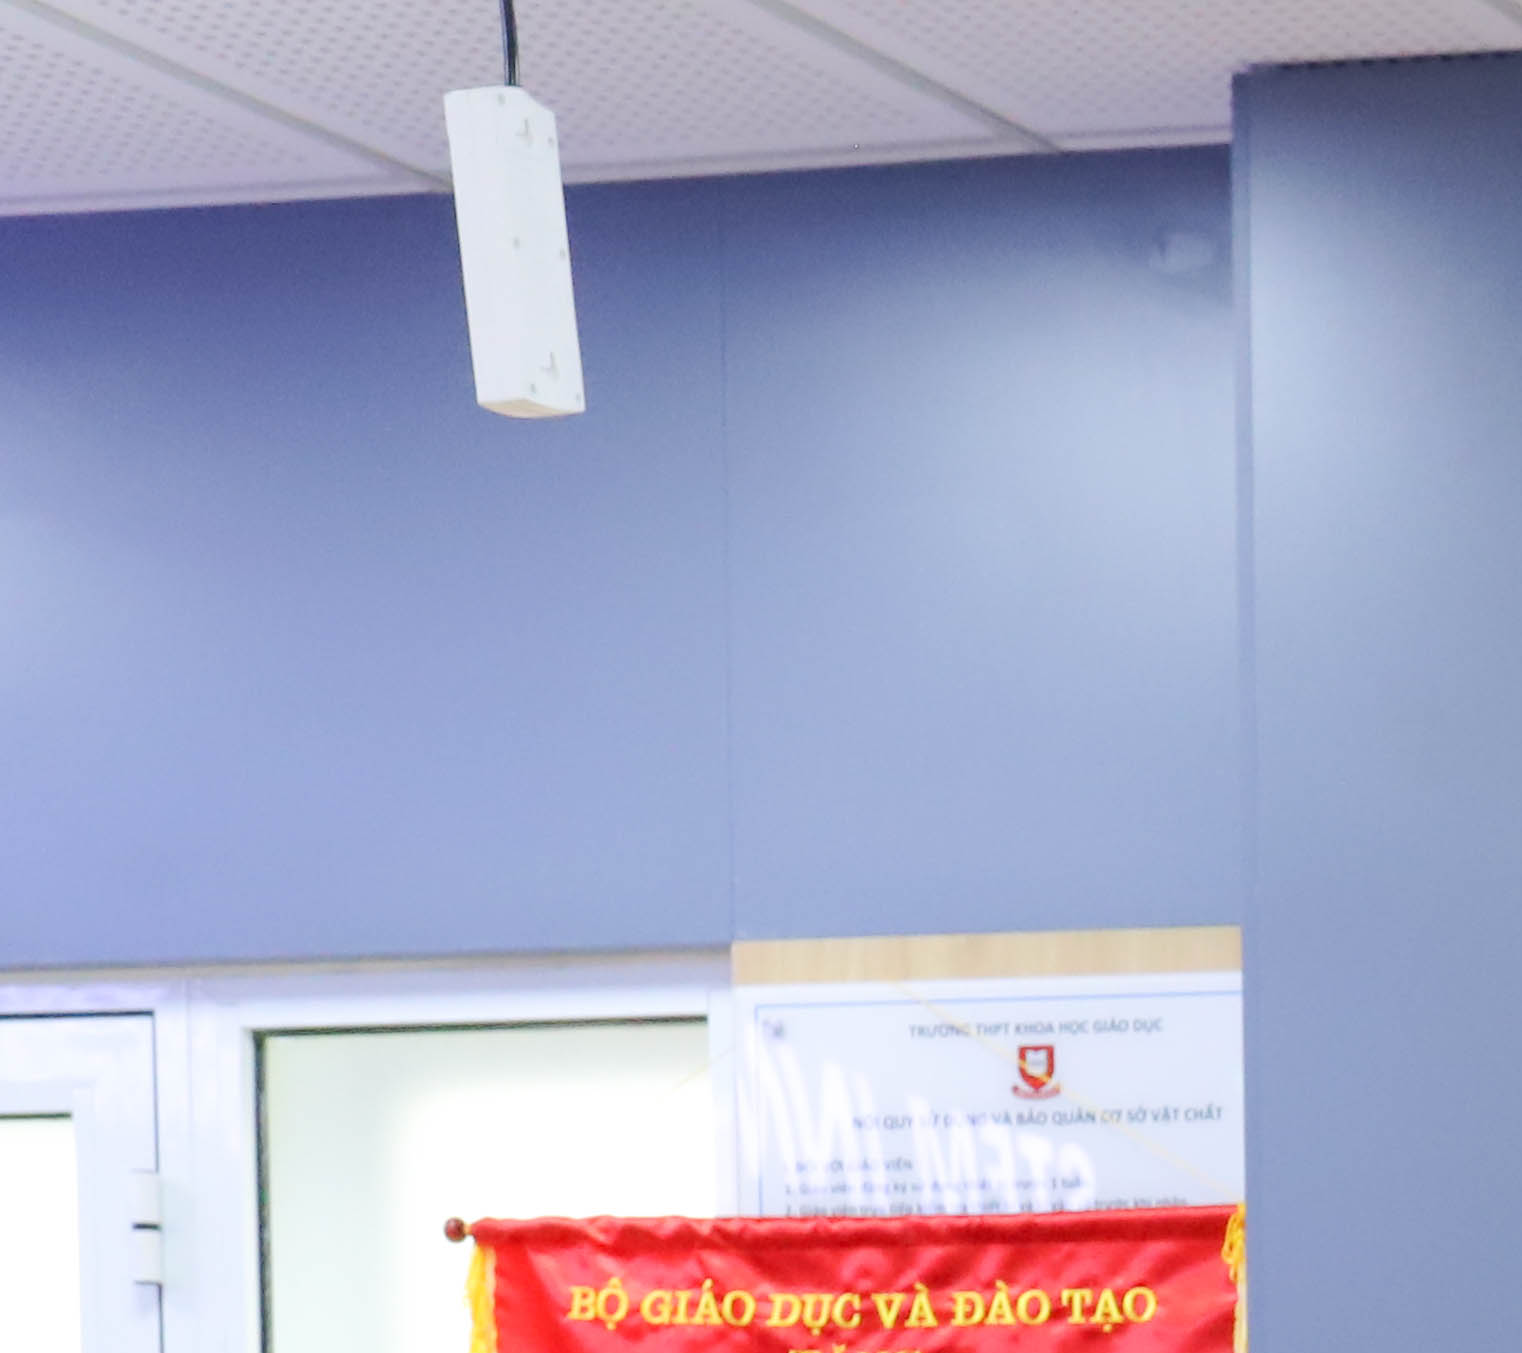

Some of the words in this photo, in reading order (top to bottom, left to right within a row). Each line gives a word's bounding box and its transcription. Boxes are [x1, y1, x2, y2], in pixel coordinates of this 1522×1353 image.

[976, 1021, 1011, 1037] THPT
[1014, 1020, 1055, 1036] KHOA
[567, 1280, 629, 1331] BỘ
[640, 1281, 755, 1327] GIÁO
[766, 1292, 861, 1335] DỤC
[872, 1282, 937, 1328] VÀ
[951, 1281, 1050, 1327] ĐÀO
[1062, 1286, 1157, 1332] TẠO
